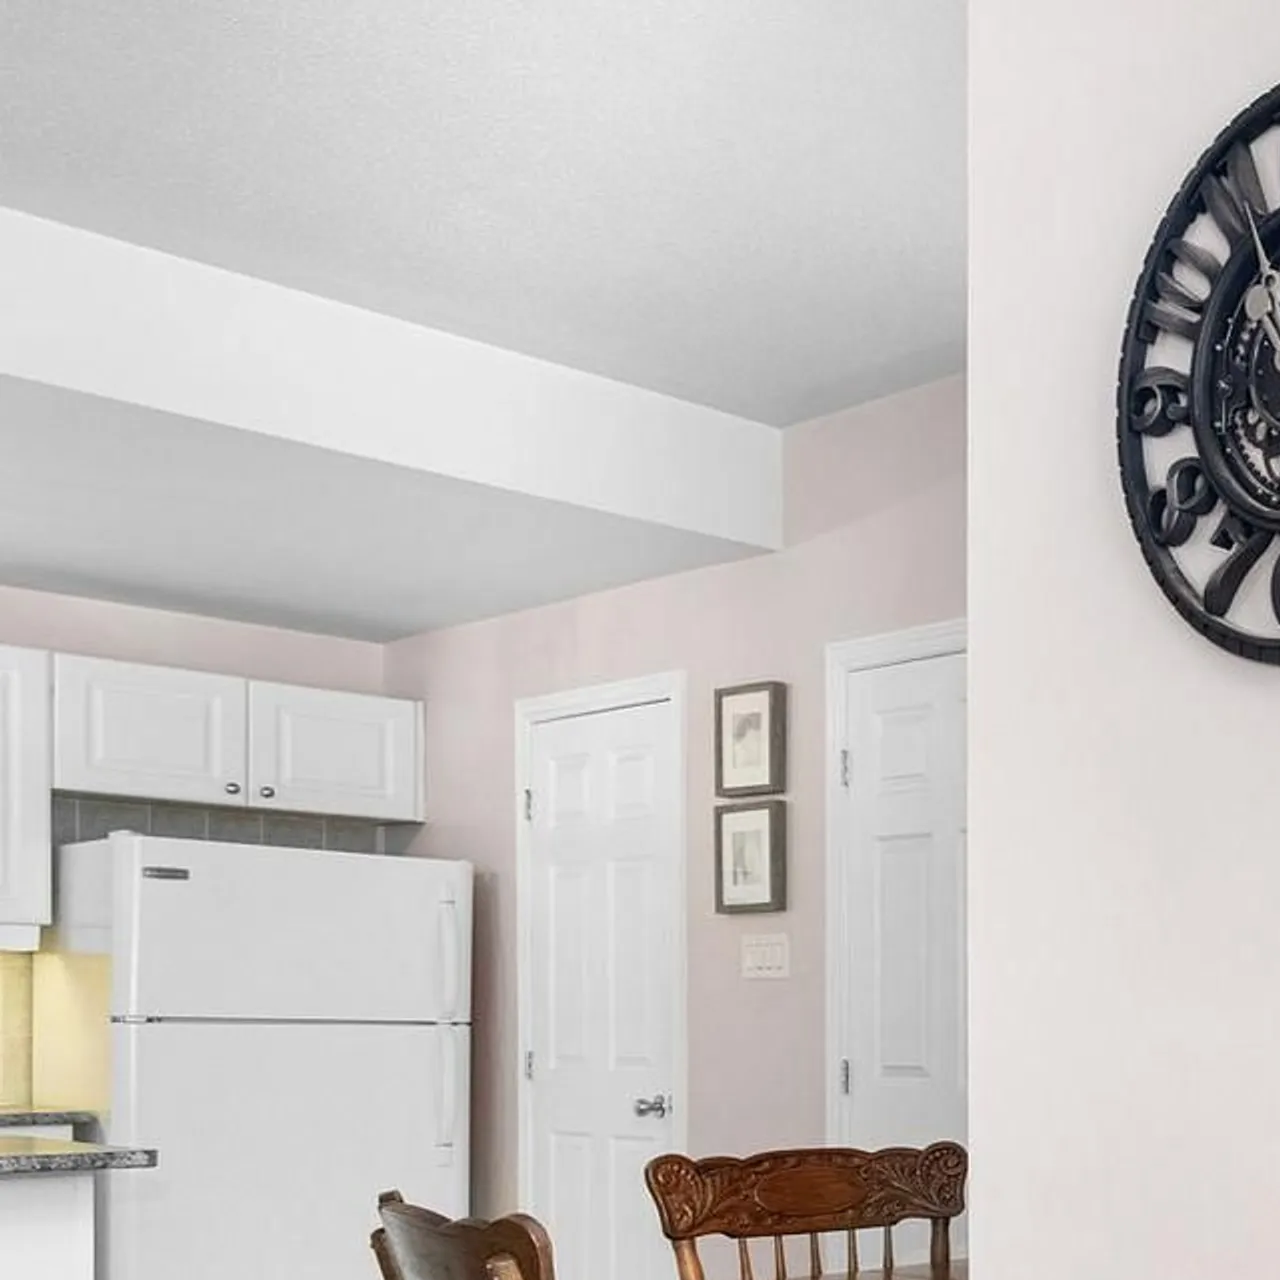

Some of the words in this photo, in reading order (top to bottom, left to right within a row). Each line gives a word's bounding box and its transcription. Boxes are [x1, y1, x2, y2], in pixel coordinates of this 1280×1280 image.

[1140, 236, 1226, 345] 10
[1130, 366, 1192, 438] 9
[1150, 456, 1219, 548] 8
[1203, 508, 1275, 618] 7
